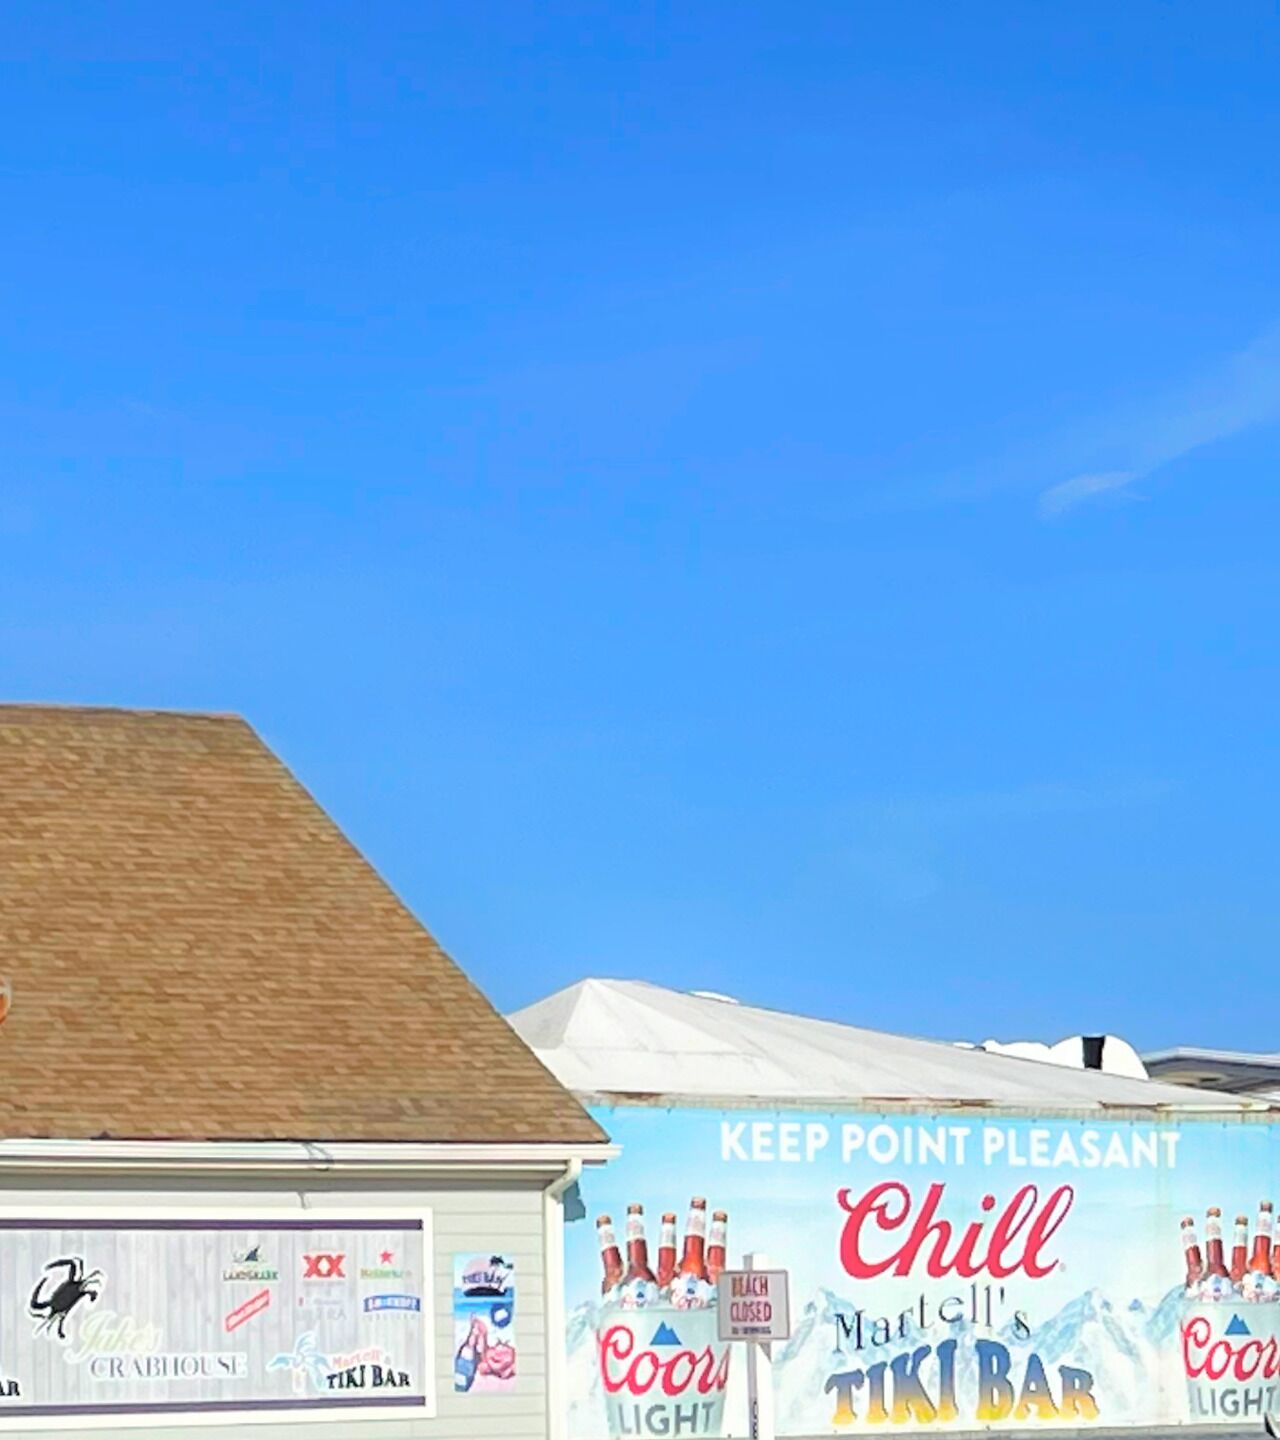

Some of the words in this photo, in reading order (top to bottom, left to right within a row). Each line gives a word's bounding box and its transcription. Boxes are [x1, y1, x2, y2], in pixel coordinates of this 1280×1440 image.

[721, 1121, 829, 1162] KEEP
[841, 1123, 971, 1165] POINT
[983, 1127, 1181, 1168] PLEASANT
[837, 1181, 1074, 1279] Chill
[303, 1254, 346, 1278] XX
[731, 1276, 768, 1297] BEACH
[731, 1301, 771, 1322] CLOSED
[833, 1281, 1031, 1355] Martell's
[91, 1356, 246, 1378] CRABHOUSE
[326, 1365, 366, 1389] TIKI
[372, 1364, 411, 1387] BAR
[596, 1325, 731, 1396] Coors
[824, 1338, 958, 1424] TIKI
[975, 1338, 1100, 1420] BAR
[1196, 1385, 1277, 1417] LIGHT
[618, 1402, 715, 1436] LIGHT
